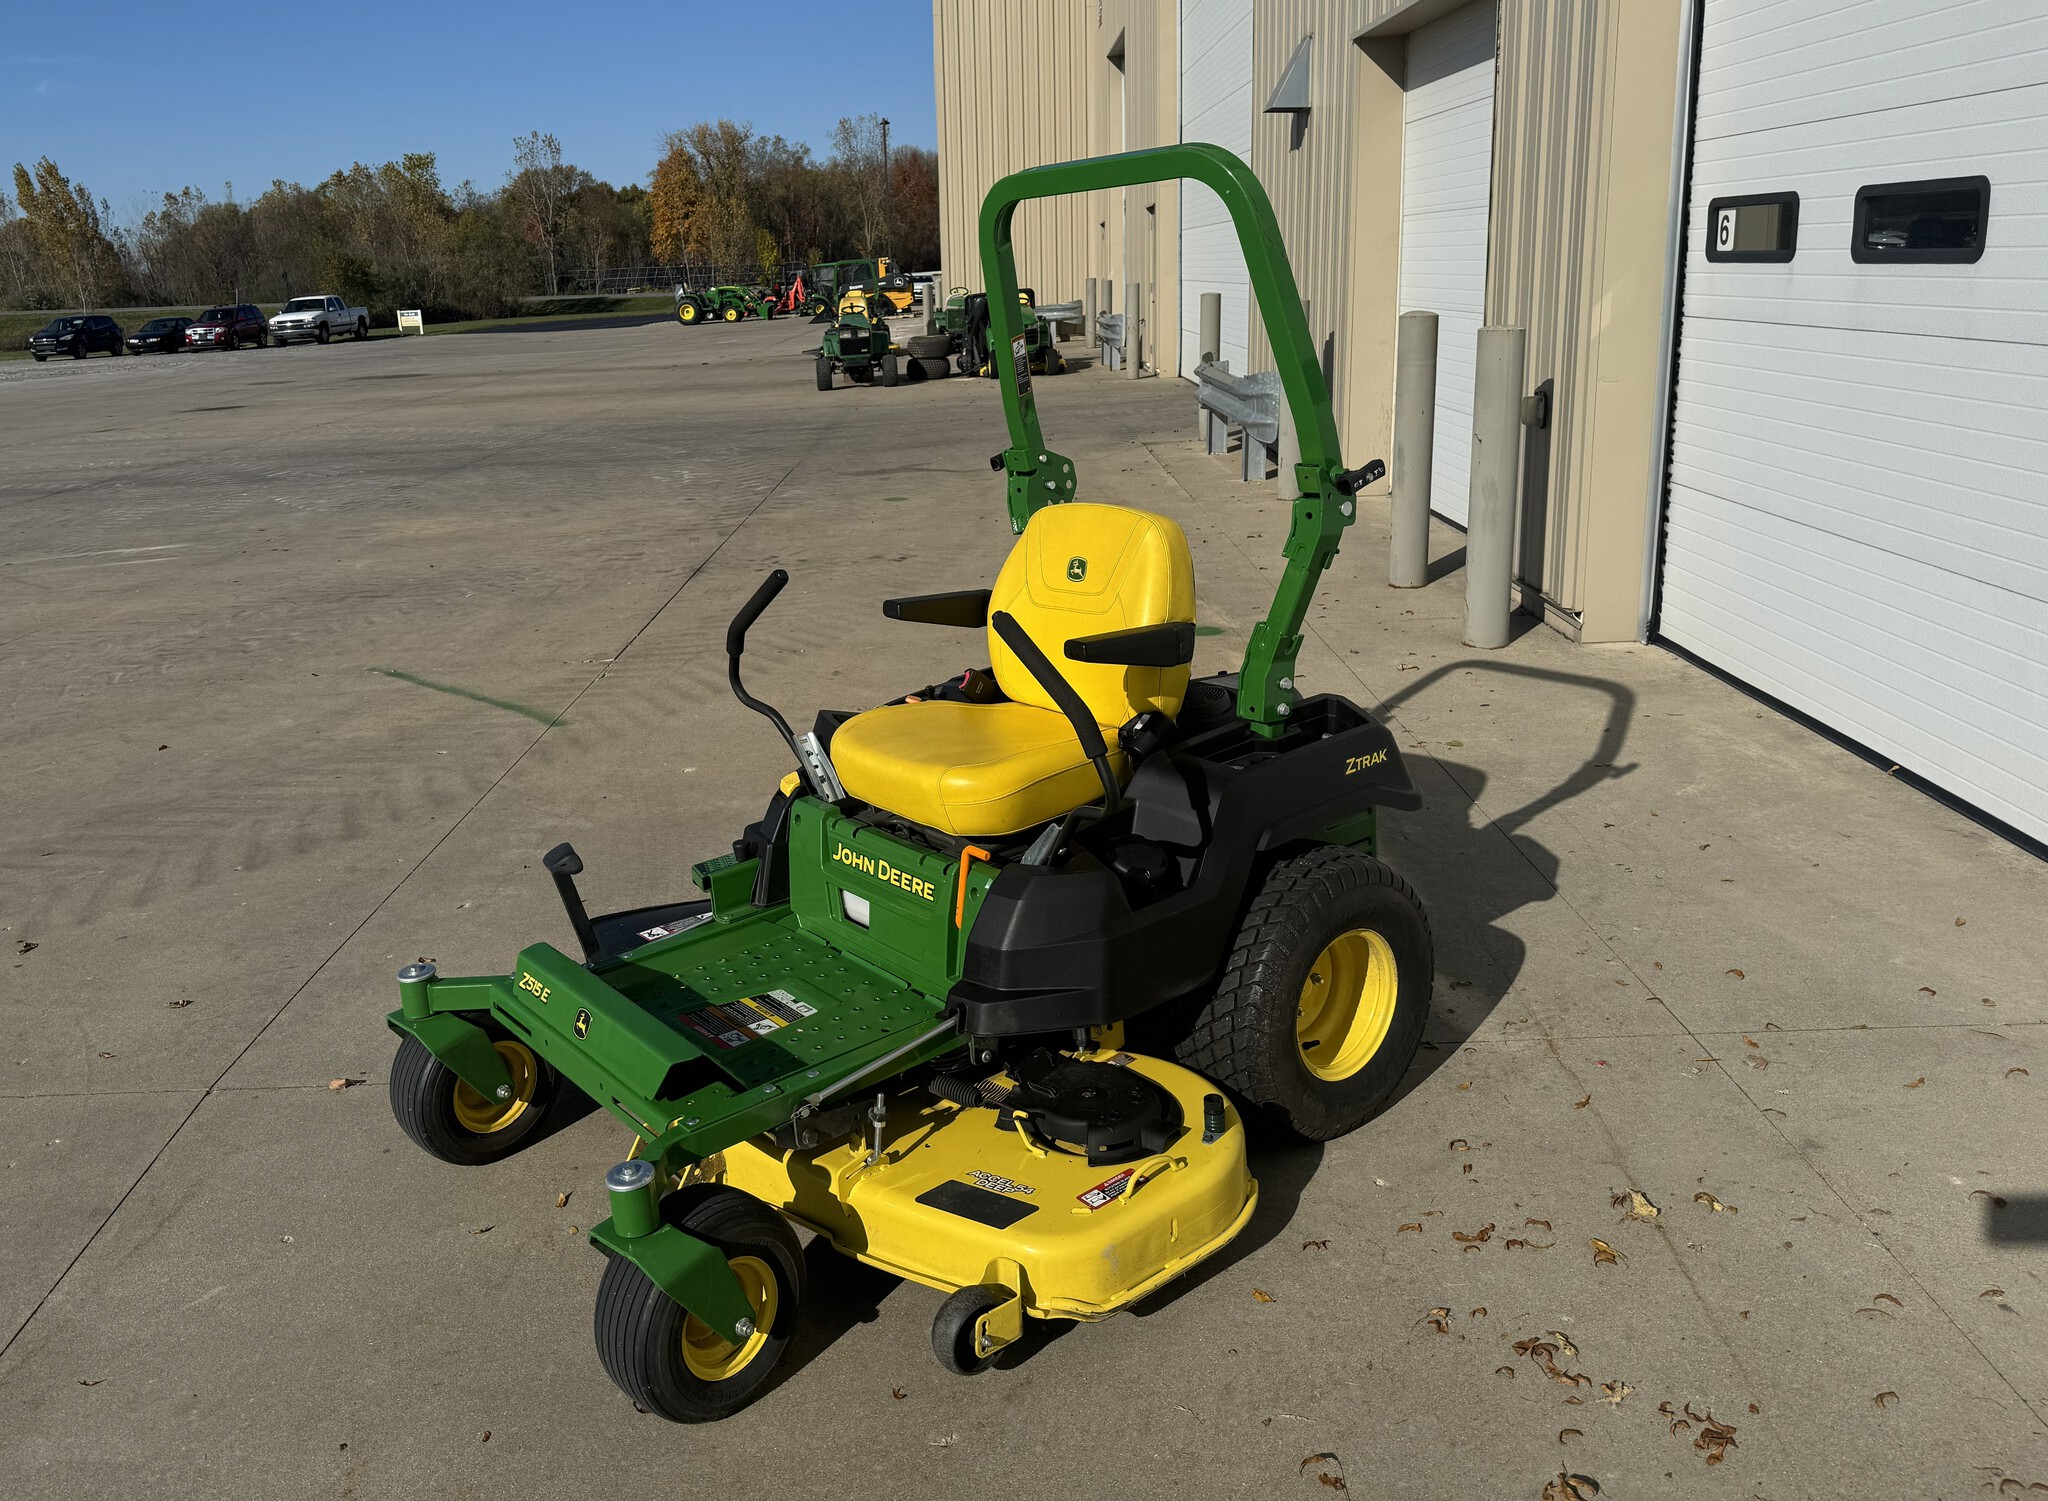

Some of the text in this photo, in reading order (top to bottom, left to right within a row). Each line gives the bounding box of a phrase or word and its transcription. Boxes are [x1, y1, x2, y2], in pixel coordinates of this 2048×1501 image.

[1720, 214, 1730, 246] 6
[1345, 748, 1388, 775] ZTRAK
[832, 842, 935, 902] JOHN DEERE
[966, 1169, 1036, 1195] ACCEL 54
[973, 1178, 1016, 1194] DEEP
